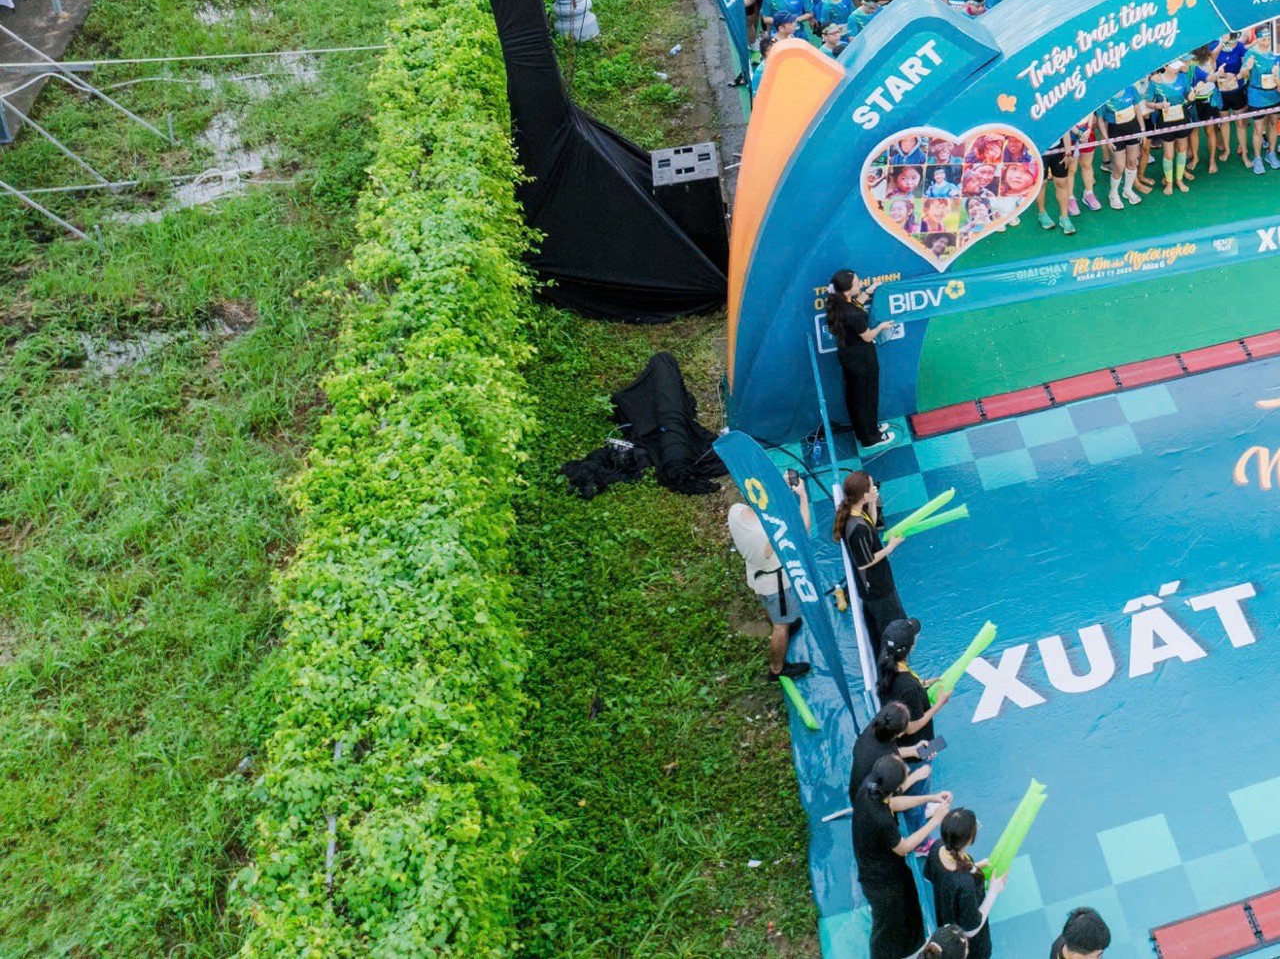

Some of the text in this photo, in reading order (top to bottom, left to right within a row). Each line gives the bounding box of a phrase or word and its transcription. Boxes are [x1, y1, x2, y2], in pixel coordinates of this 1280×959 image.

[852, 39, 943, 130] START
[1016, 1, 1158, 89] Triệu trái tim
[1030, 17, 1181, 120] chung nhịp chạy
[889, 286, 945, 315] BIDV
[965, 580, 1258, 723] XUẤT
